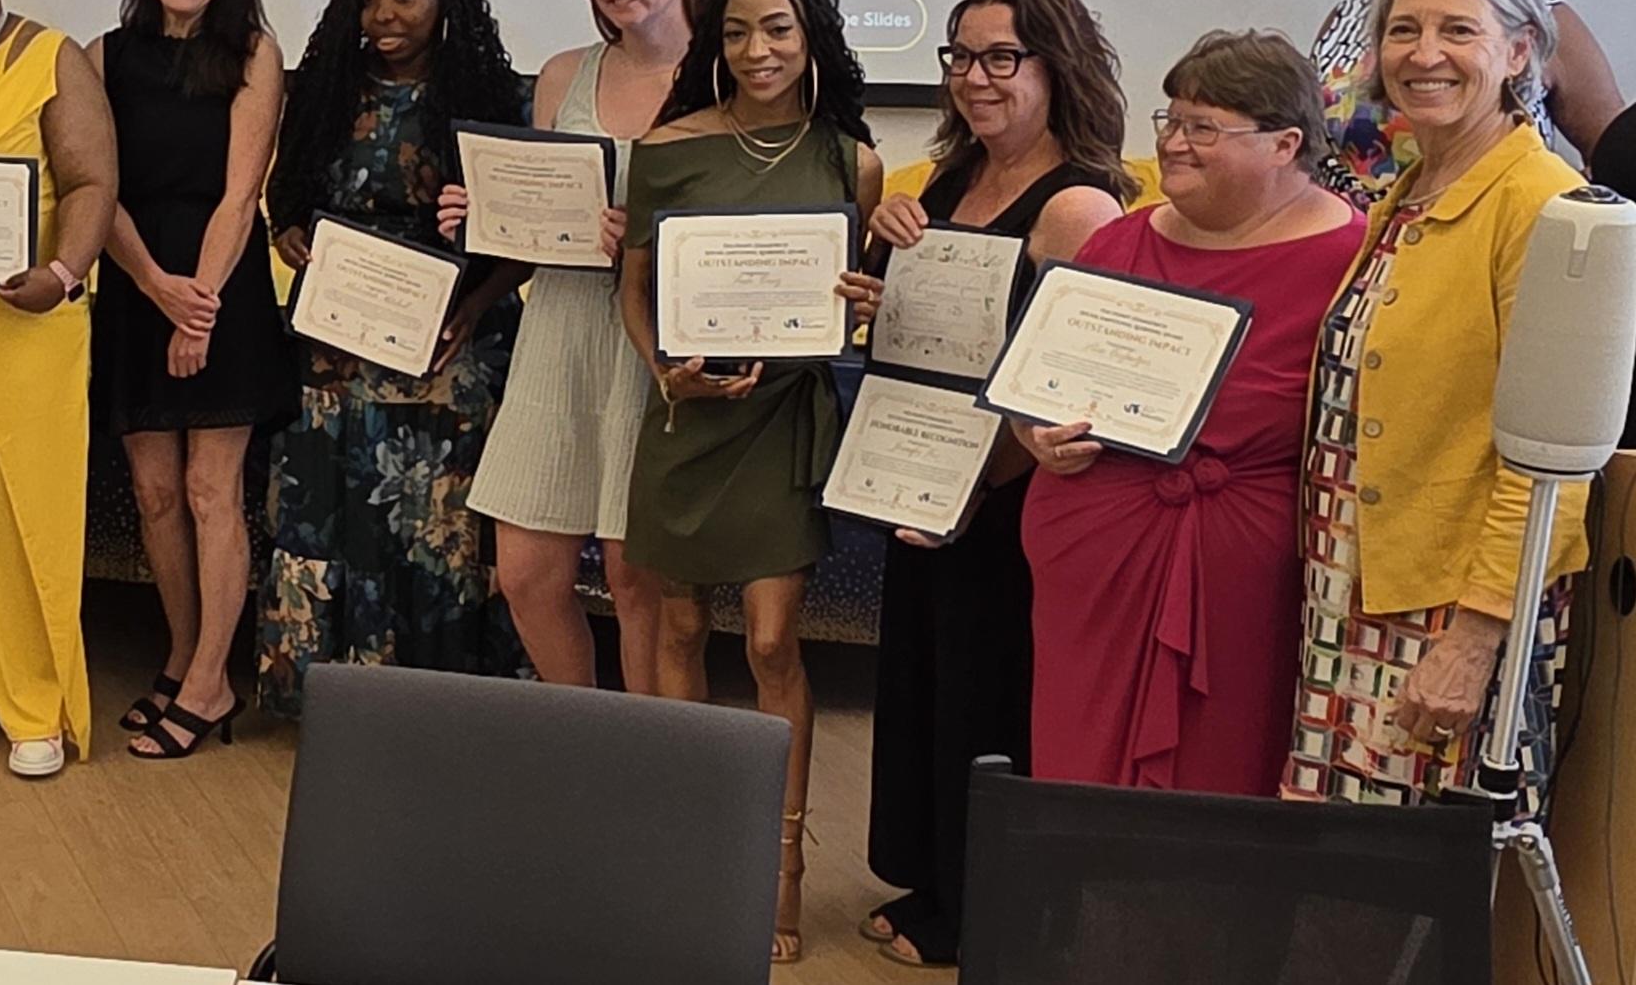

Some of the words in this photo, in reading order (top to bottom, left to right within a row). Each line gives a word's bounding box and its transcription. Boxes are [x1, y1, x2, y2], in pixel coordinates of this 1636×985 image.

[863, 11, 912, 28] Slides
[1067, 317, 1148, 345] OUTSTANDING
[1148, 338, 1192, 357] IMPACT
